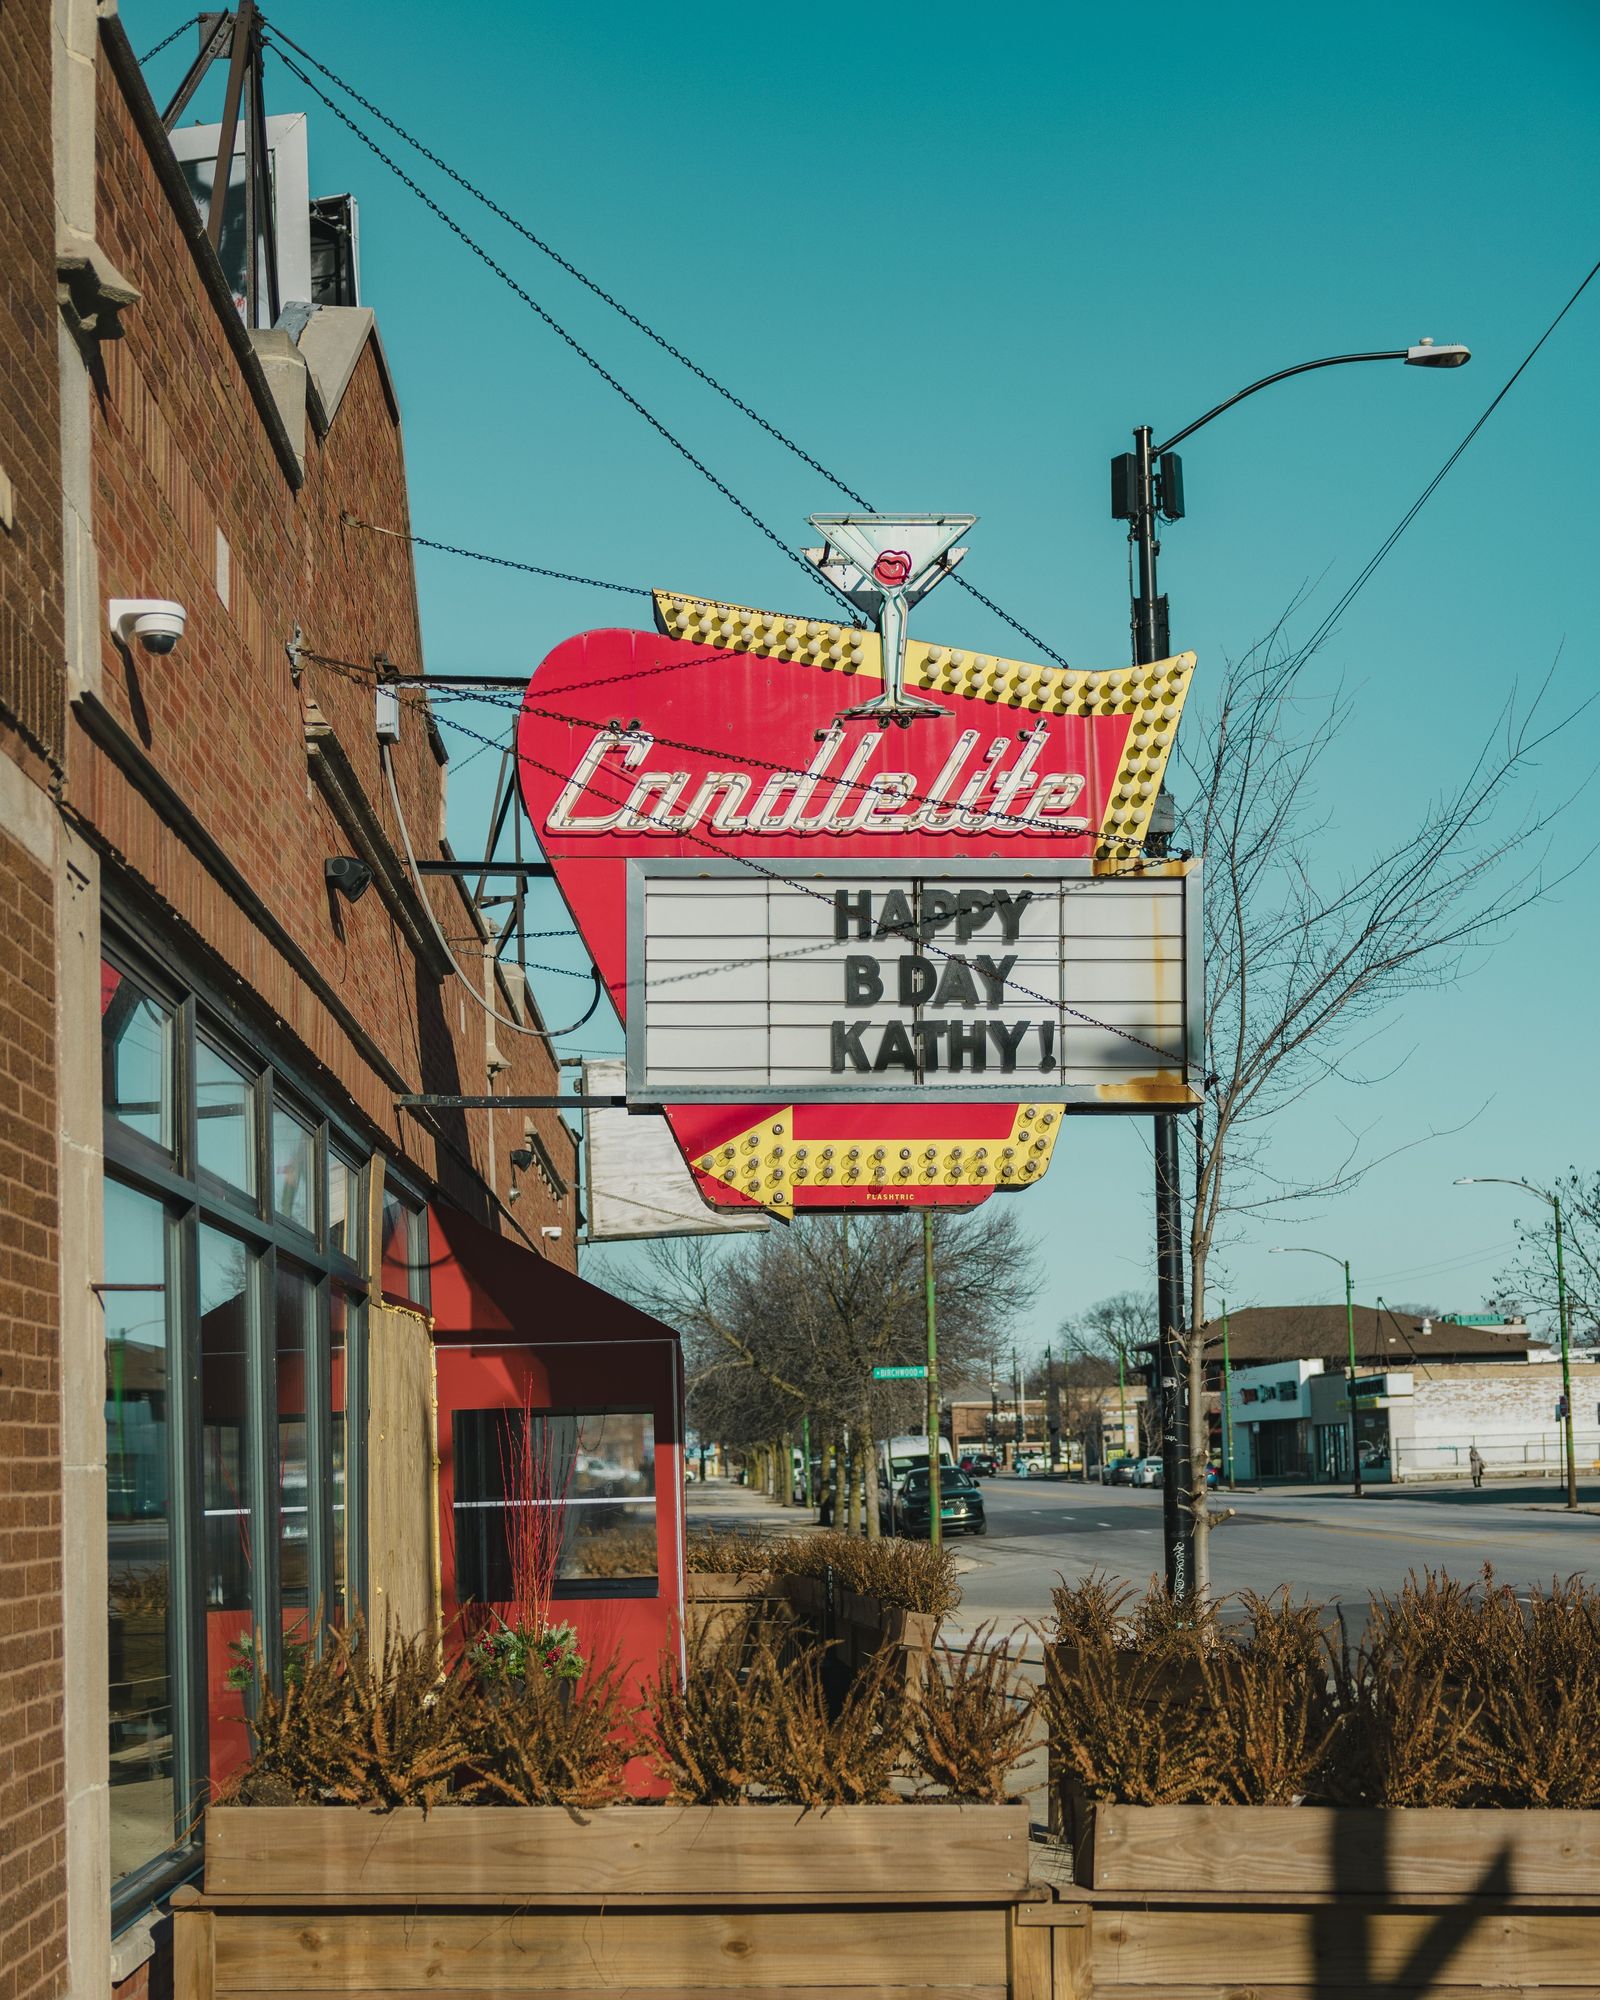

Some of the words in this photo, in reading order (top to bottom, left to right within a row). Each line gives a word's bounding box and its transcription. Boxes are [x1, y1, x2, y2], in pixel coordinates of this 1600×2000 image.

[546, 728, 1092, 832] Candlelite
[835, 889, 1032, 940] HAPPY
[846, 954, 884, 1005] B
[898, 954, 1019, 1005] DAY
[831, 1020, 1057, 1071] KATHY!
[880, 1368, 918, 1377] BIRCHWOOD
